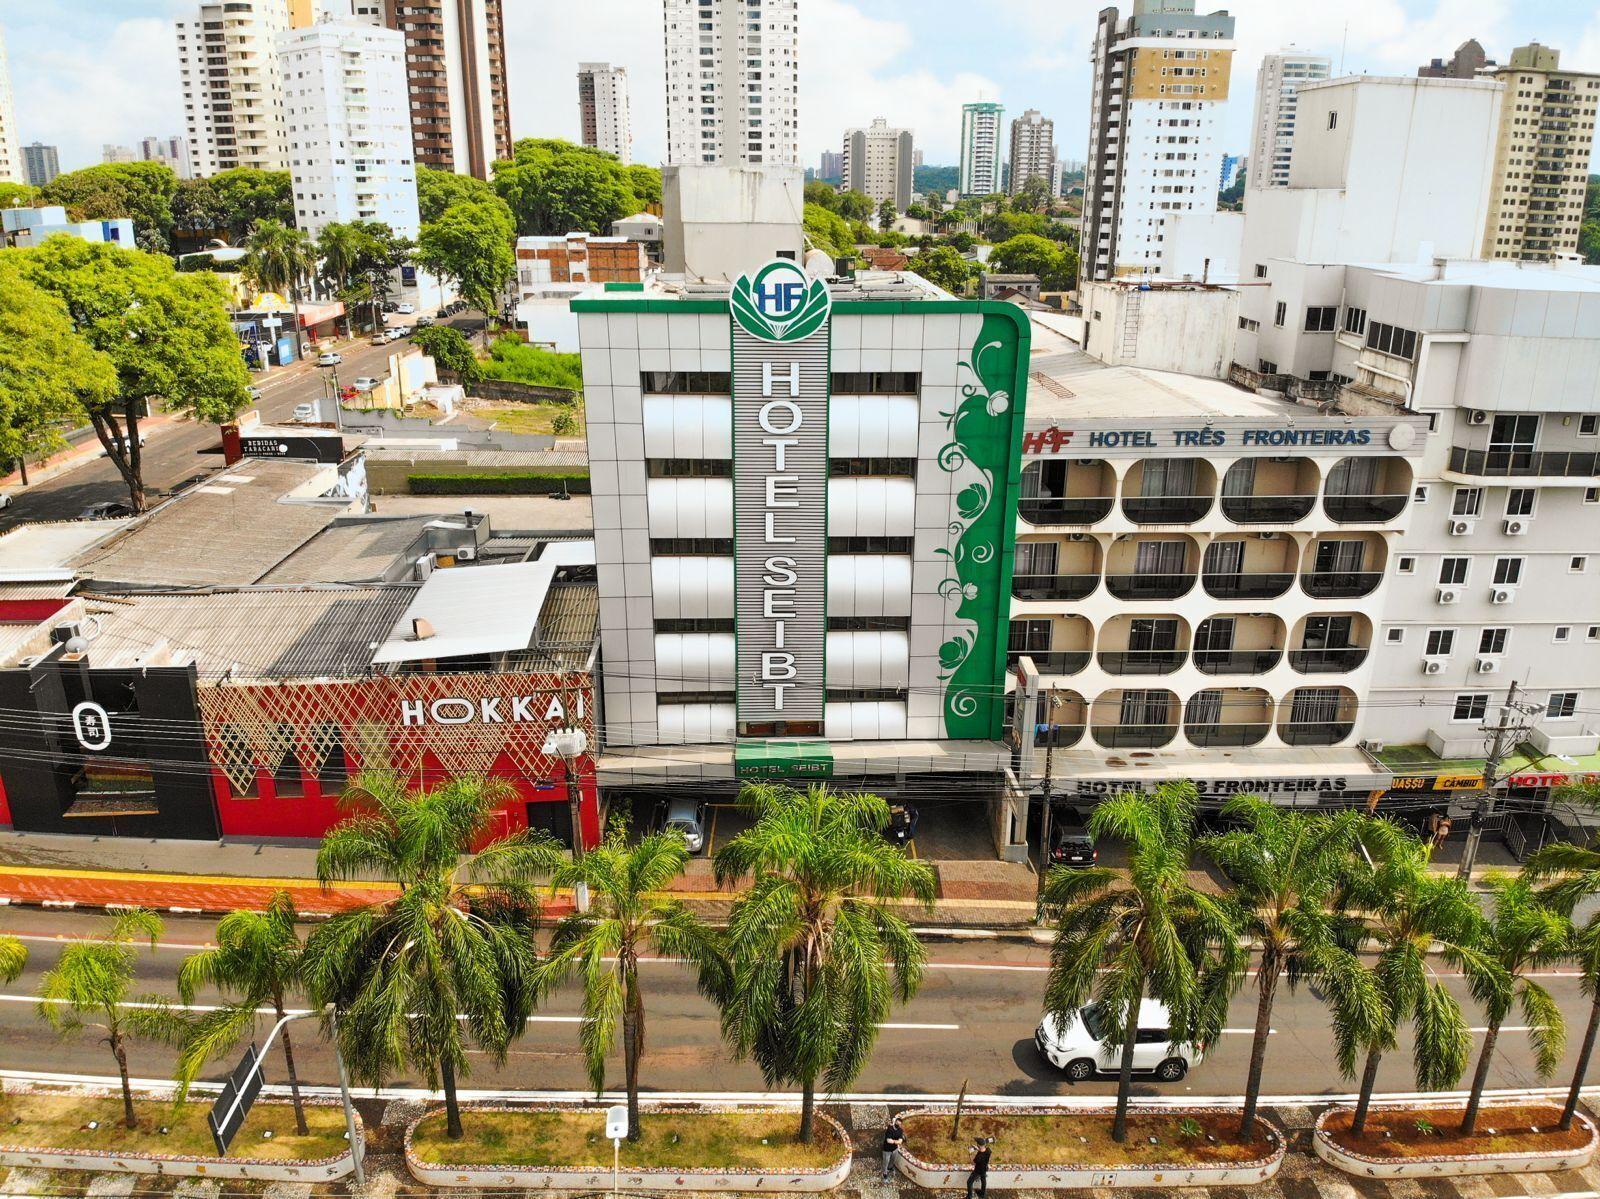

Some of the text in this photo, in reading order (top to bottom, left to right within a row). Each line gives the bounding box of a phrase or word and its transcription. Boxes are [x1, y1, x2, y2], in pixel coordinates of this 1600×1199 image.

[758, 282, 804, 313] HF
[1089, 431, 1158, 448] HOTEL
[1173, 427, 1226, 447] TRÊS
[1242, 429, 1371, 446] FRONTEIRAS
[758, 361, 803, 710] HOTEL SEIBT
[401, 690, 585, 727] HOKKAI
[740, 763, 829, 774] HOTEL SEIBT
[1213, 777, 1348, 793] FRONTEIRAS
